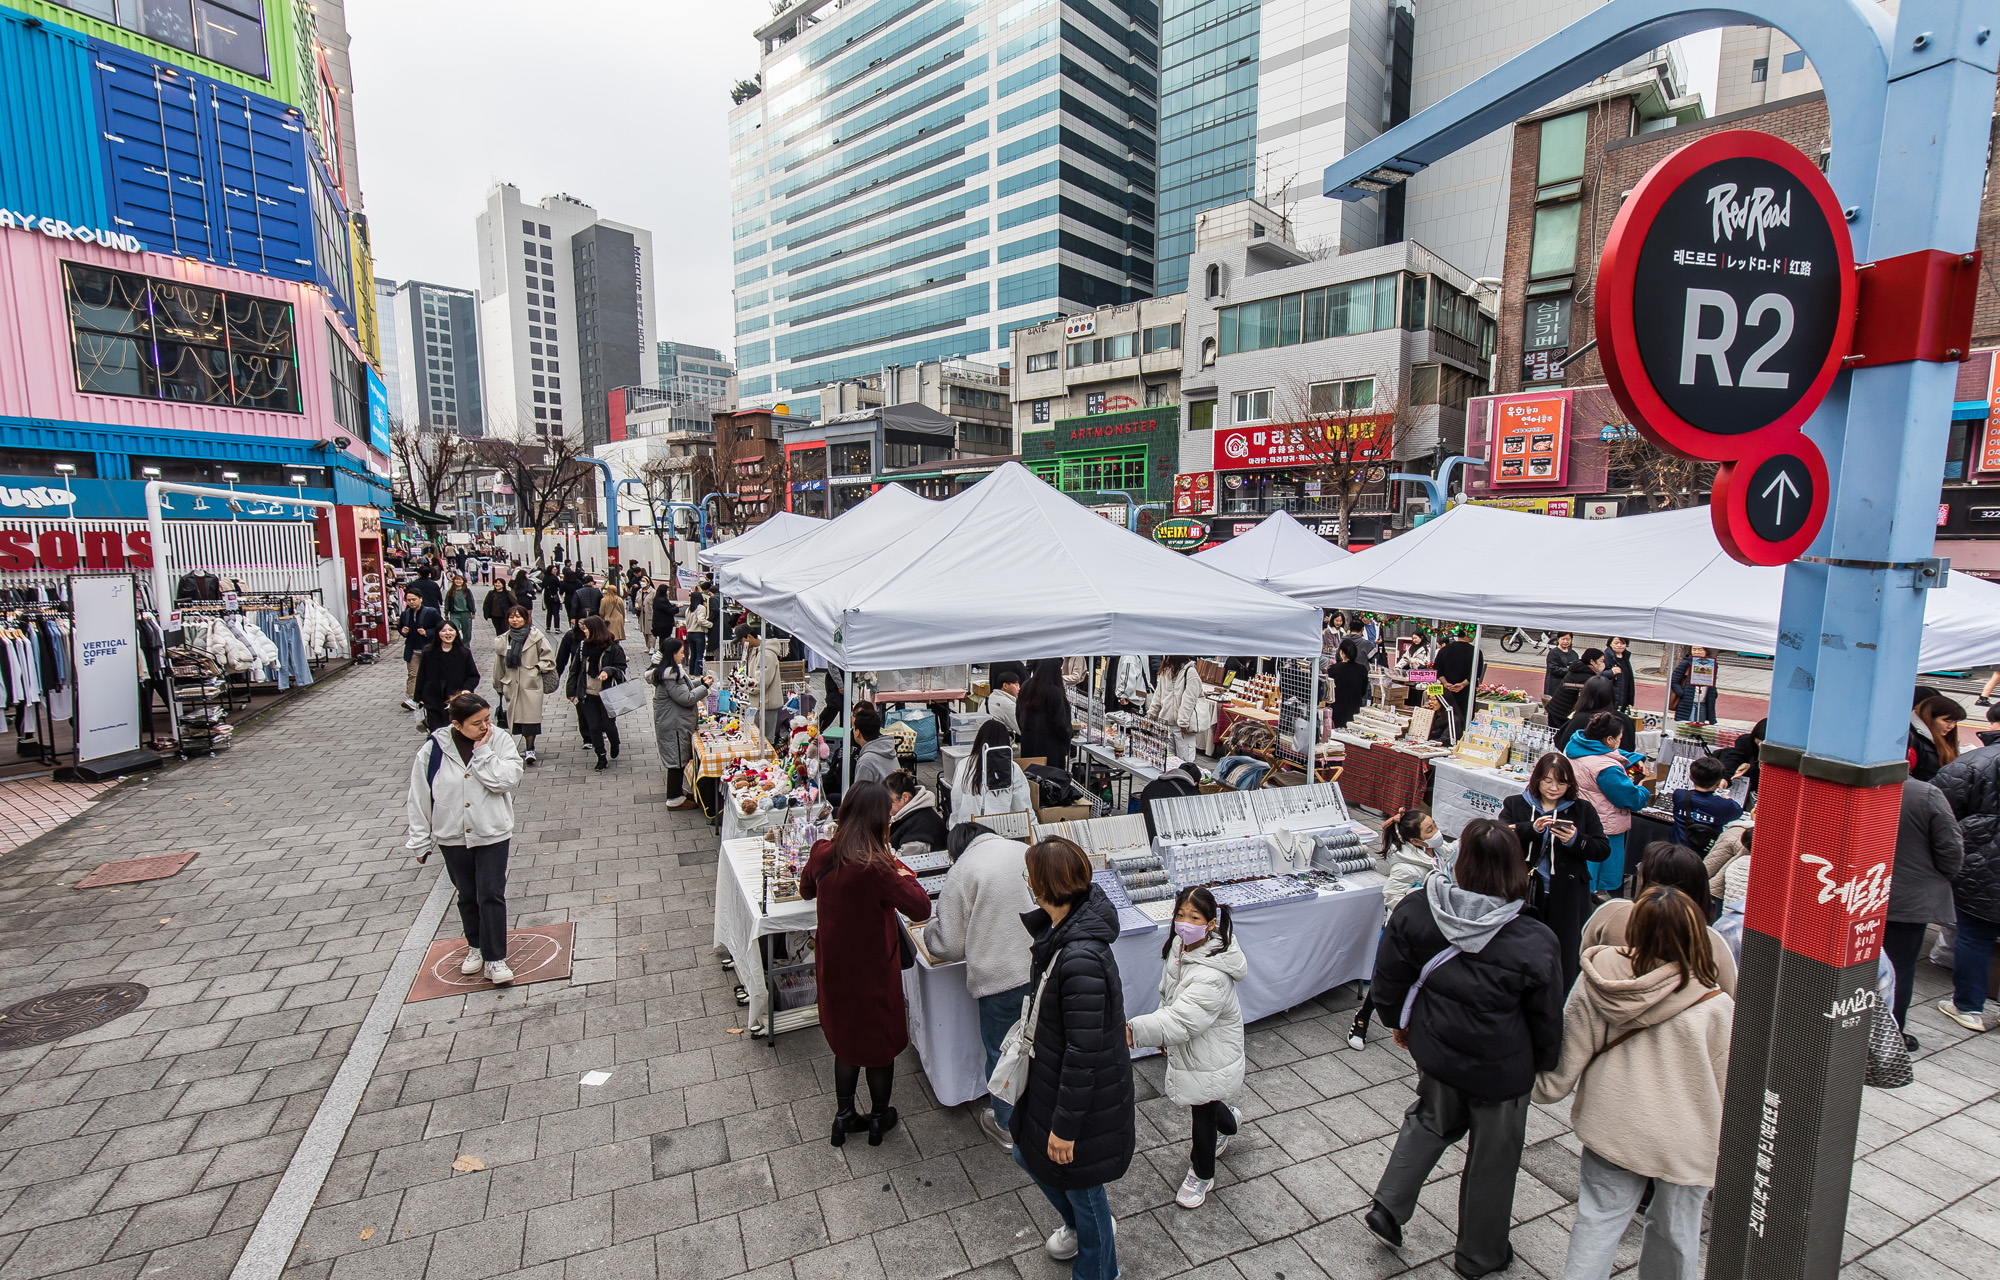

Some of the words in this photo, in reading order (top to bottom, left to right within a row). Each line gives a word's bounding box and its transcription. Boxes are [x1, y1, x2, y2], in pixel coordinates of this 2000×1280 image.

[1673, 249, 1717, 267] 레드로드
[1727, 255, 1781, 273] レッドロード
[633, 246, 642, 291] Mercure
[1789, 259, 1812, 277] 红路
[1533, 300, 1561, 347] 심리카페
[1679, 287, 1795, 389] R2
[1524, 351, 1548, 366] 성격
[1532, 361, 1565, 381] 궁합
[1070, 420, 1157, 441] ARTMONSTER
[1190, 527, 1200, 537] Hi
[1316, 523, 1351, 536] BEE
[0, 530, 154, 570] sons
[83, 638, 128, 650] VERTICAL
[83, 648, 117, 658] COFFEE
[83, 658, 95, 667] 3F
